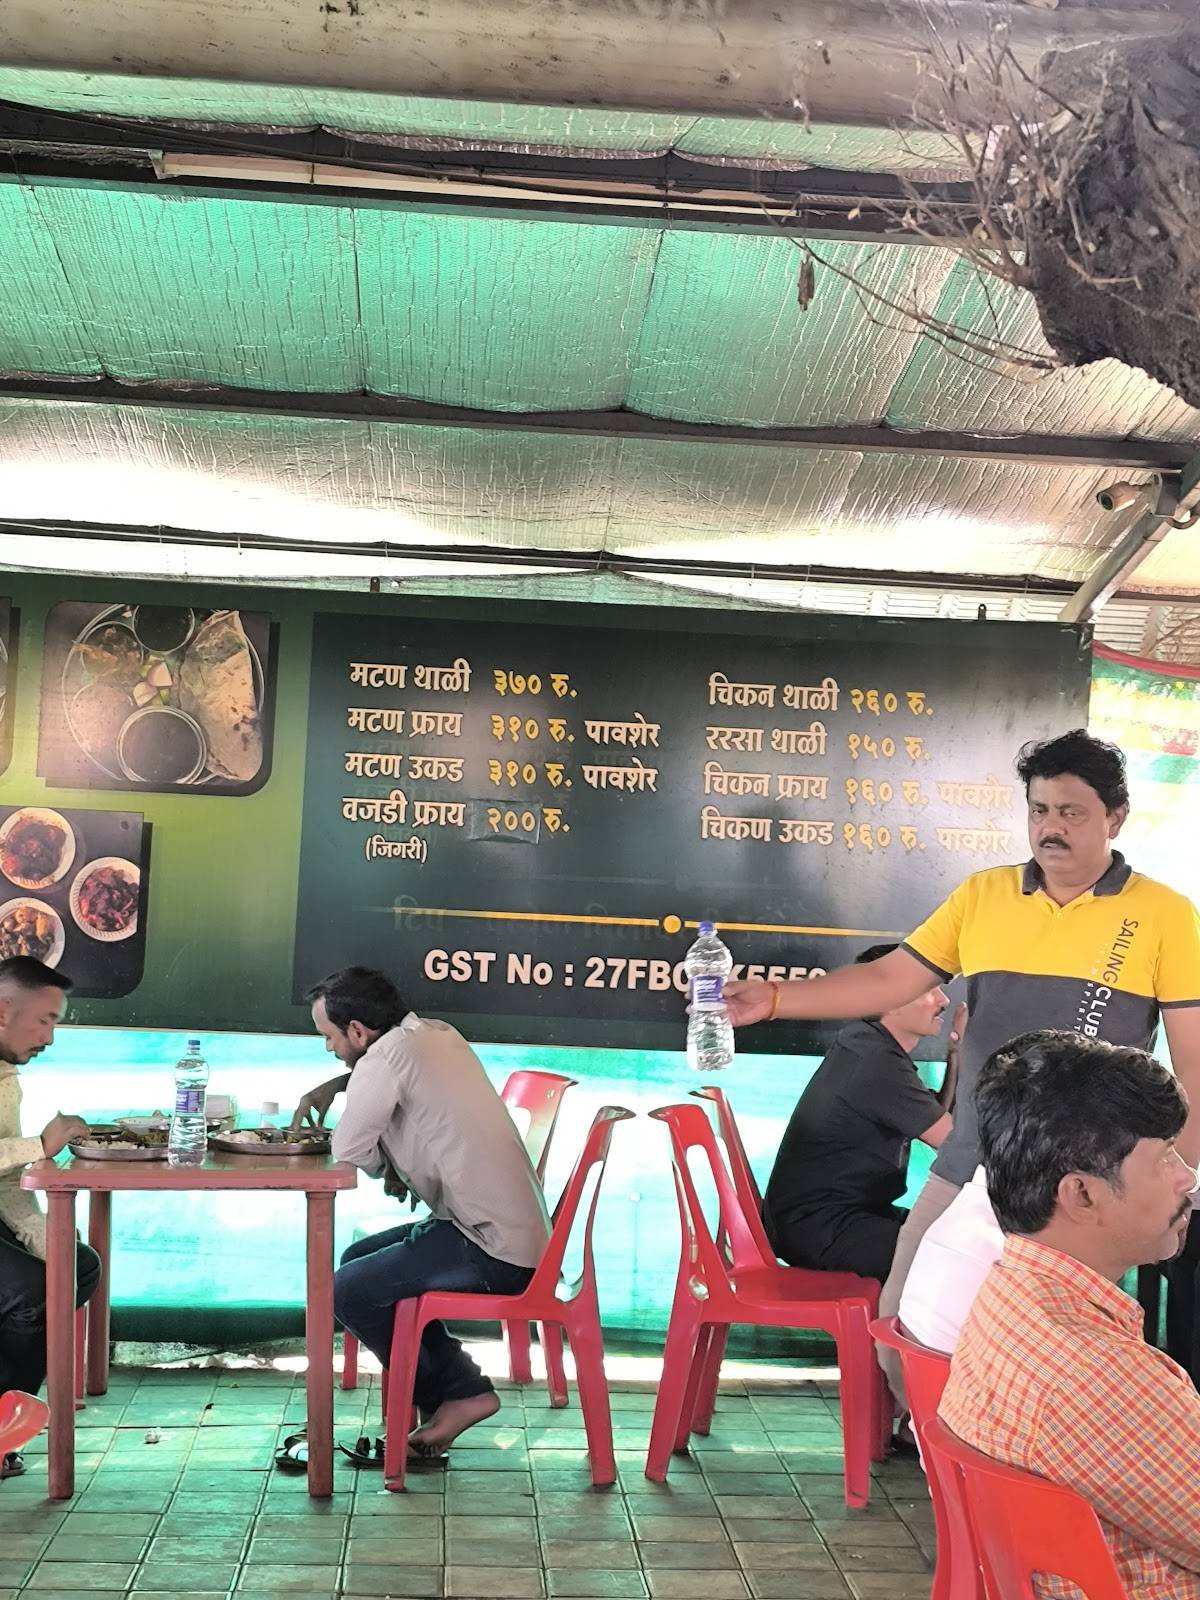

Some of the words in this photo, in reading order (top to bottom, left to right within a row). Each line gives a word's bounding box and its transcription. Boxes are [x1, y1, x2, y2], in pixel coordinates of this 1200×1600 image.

[350, 662, 407, 688] मटण
[414, 658, 472, 693] थाळी
[494, 669, 542, 696] ३७०
[551, 673, 577, 698] रु.
[709, 672, 776, 707] चिकन
[783, 677, 840, 711] थाळी
[850, 688, 898, 716] २६०
[906, 691, 934, 716] रु.
[347, 708, 405, 733] मटण
[409, 711, 463, 737] फ्राय
[491, 714, 539, 742] ३१०
[548, 718, 575, 743] रु.
[584, 712, 660, 747] पावशेर
[771, 721, 827, 755] थाळी
[848, 734, 896, 760] १५०
[904, 736, 930, 761] रु.
[345, 753, 402, 778] मटण
[408, 756, 464, 782] उकड
[488, 759, 537, 787] ३१०
[545, 763, 572, 788] रु.
[582, 756, 658, 792] पावशेर
[704, 761, 771, 796] चिकन
[775, 775, 828, 801] फ्राय
[845, 778, 893, 805] १६०
[904, 780, 929, 805] रु.
[937, 774, 1014, 809] पावशेर
[342, 789, 407, 824] वजडी
[412, 801, 466, 828] फ्राय
[487, 807, 536, 833] २००
[543, 807, 570, 833] रु.
[701, 806, 773, 840] चिकण
[778, 819, 834, 845] उकड
[843, 822, 891, 850] १६०
[900, 825, 927, 850] रु.
[936, 818, 1011, 853] पावशेर
[365, 834, 428, 863] (जिगरी)
[424, 949, 496, 984] GST
[507, 954, 553, 986] No
[564, 961, 574, 987] :
[1102, 918, 1139, 983] SAILING
[1084, 986, 1112, 1037] CLUB
